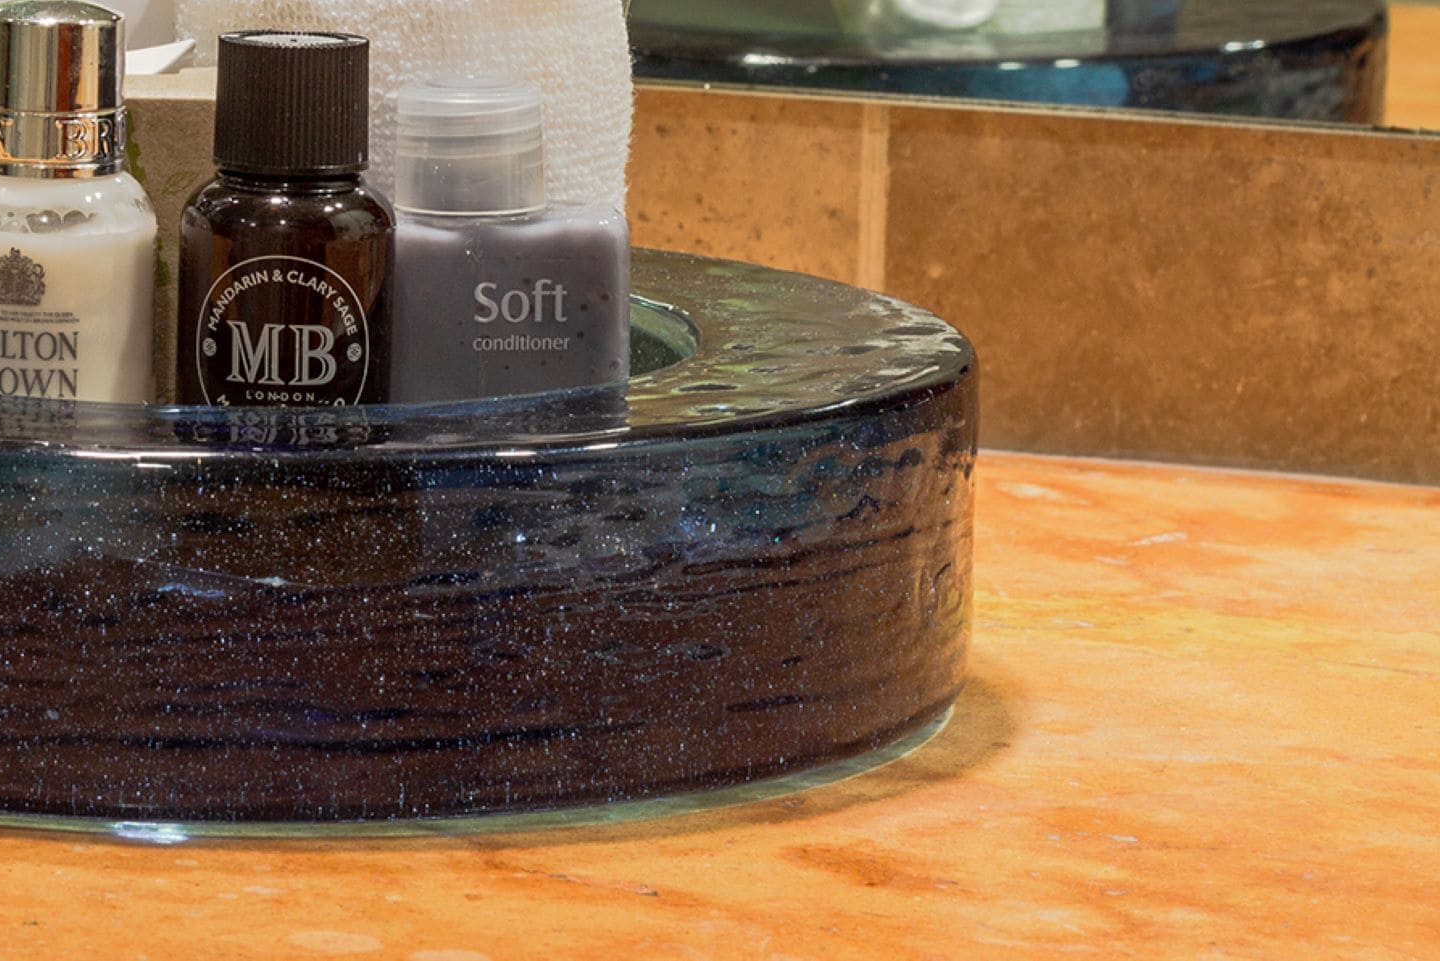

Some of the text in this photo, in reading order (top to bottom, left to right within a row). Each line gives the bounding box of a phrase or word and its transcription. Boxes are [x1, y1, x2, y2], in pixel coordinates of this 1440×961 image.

[207, 268, 359, 337] MANDARIN & CLARY SAGE
[473, 278, 568, 325] Soft
[225, 319, 338, 386] MB
[472, 334, 570, 352] conditioner
[245, 390, 315, 403] LONDON
